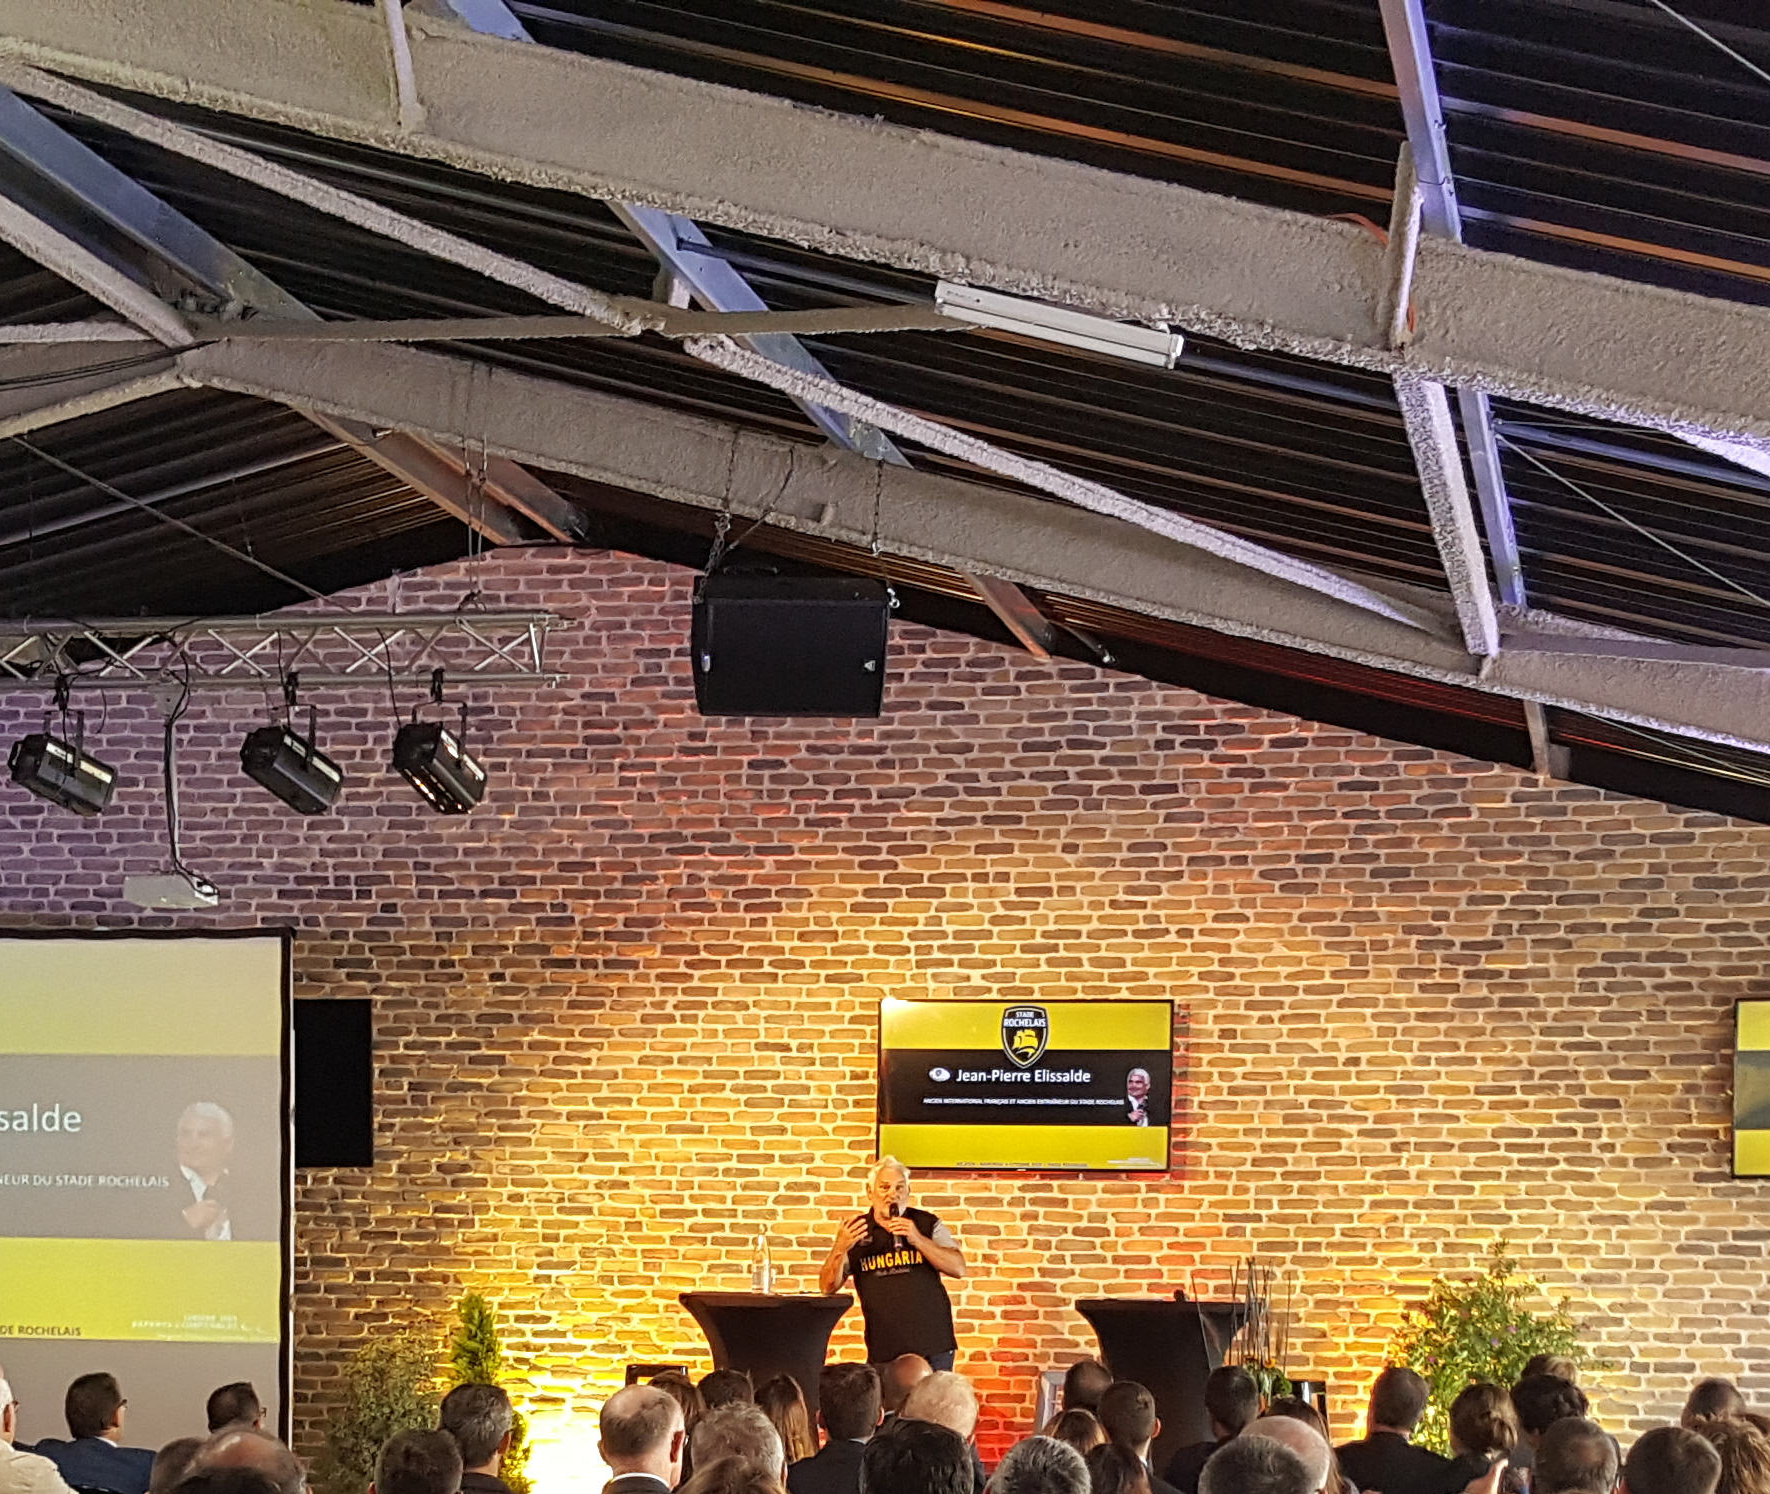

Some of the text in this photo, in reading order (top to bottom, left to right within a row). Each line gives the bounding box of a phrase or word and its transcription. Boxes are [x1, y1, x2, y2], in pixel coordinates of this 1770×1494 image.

[1003, 1018, 1046, 1027] ROCHELAIS
[956, 1069, 1091, 1083] Jean-Pierre Elissalde
[33, 1174, 52, 1185] DU
[56, 1174, 93, 1187] STADE
[99, 1175, 170, 1188] ROCHELAIS
[860, 1250, 923, 1272] HUNGARIA
[18, 1326, 81, 1337] ROCHELAIS
